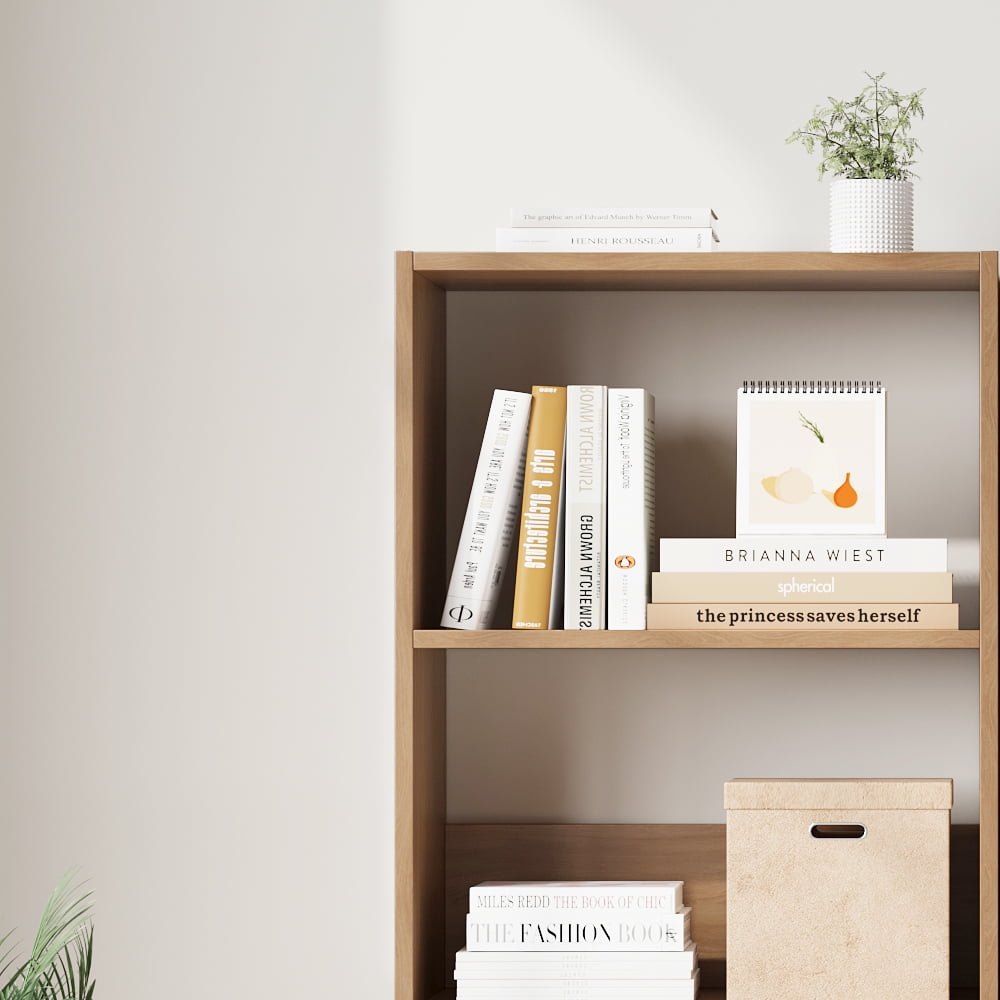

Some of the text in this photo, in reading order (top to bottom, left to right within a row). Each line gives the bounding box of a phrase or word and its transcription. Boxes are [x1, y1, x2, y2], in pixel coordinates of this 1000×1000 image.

[571, 237, 674, 245] HENRI ROUSSEAU
[725, 549, 886, 562] BRIANNA WIEST
[777, 576, 835, 597] spherical
[696, 608, 921, 626] the princess saves herself
[477, 896, 666, 909] MILES REDD THE BOOK OF CHIC
[471, 924, 515, 943] THE
[522, 924, 611, 943] FASHION
